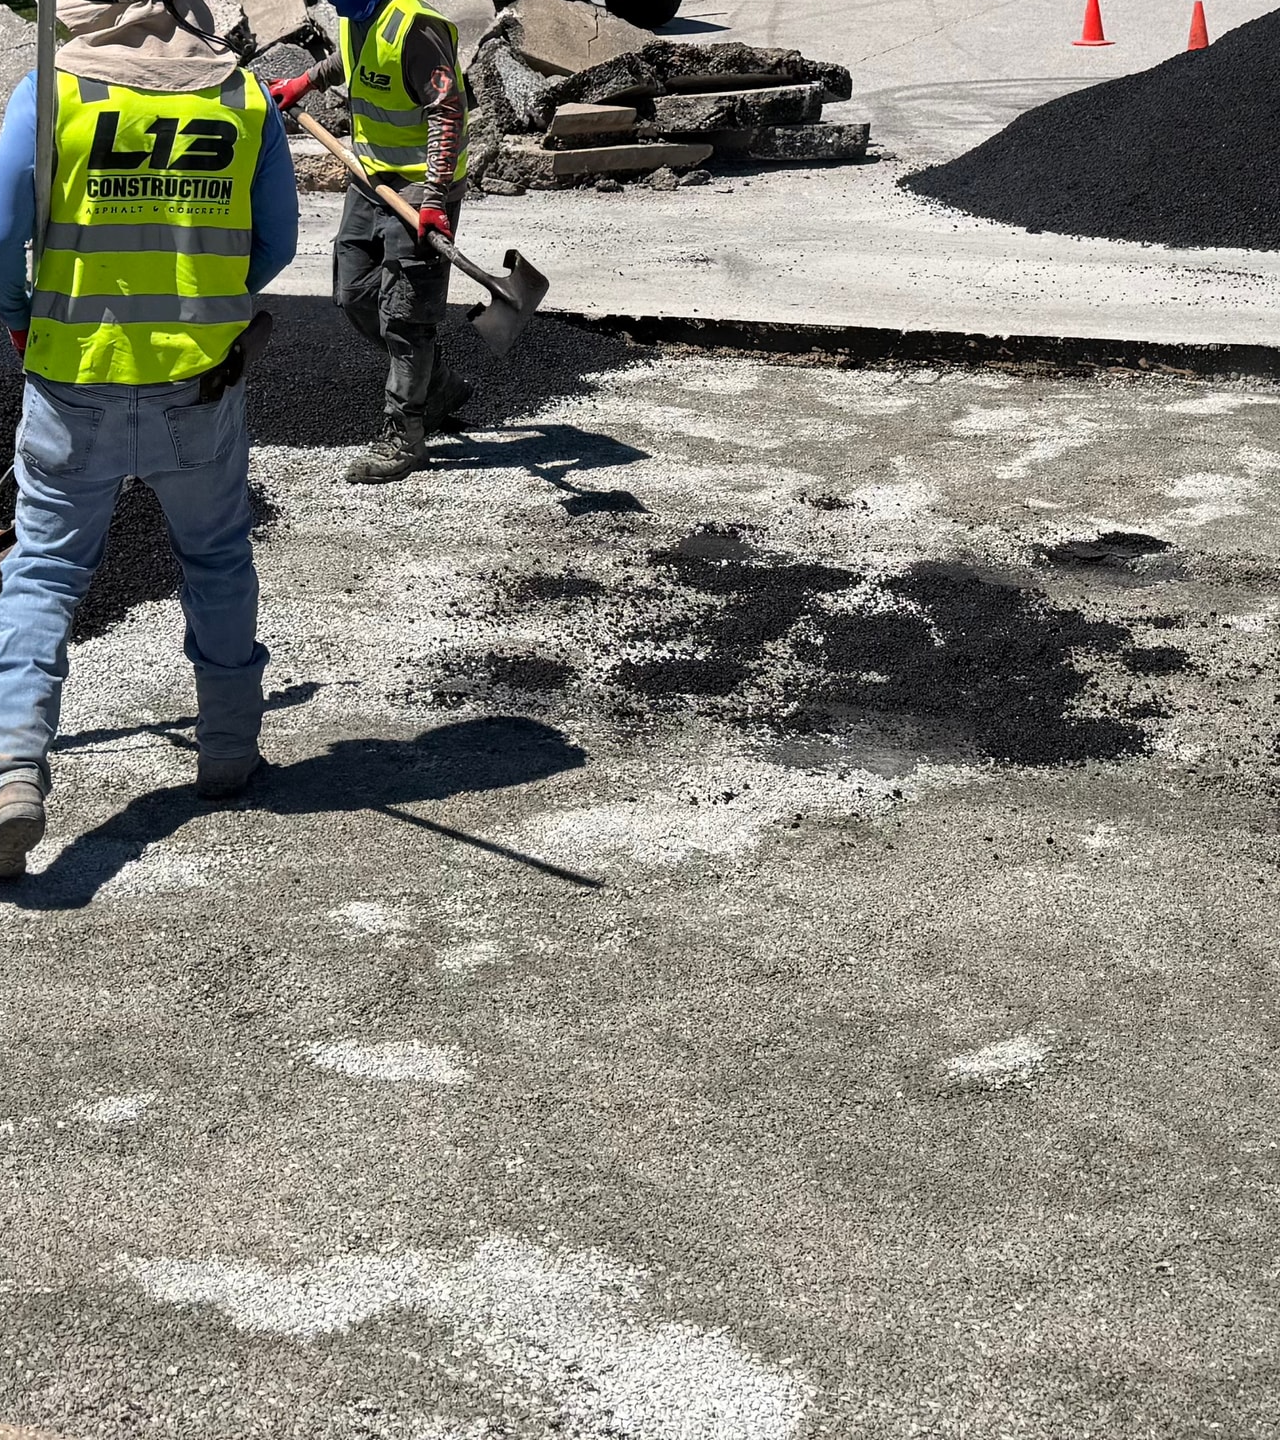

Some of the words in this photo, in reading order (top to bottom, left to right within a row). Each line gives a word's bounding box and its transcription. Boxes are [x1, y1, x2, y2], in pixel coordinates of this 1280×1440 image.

[360, 65, 391, 86] L13
[87, 111, 238, 171] L13
[87, 177, 233, 199] CONSTRUCTION
[86, 205, 143, 215] ASPHALT
[168, 206, 230, 215] CONCRETE
